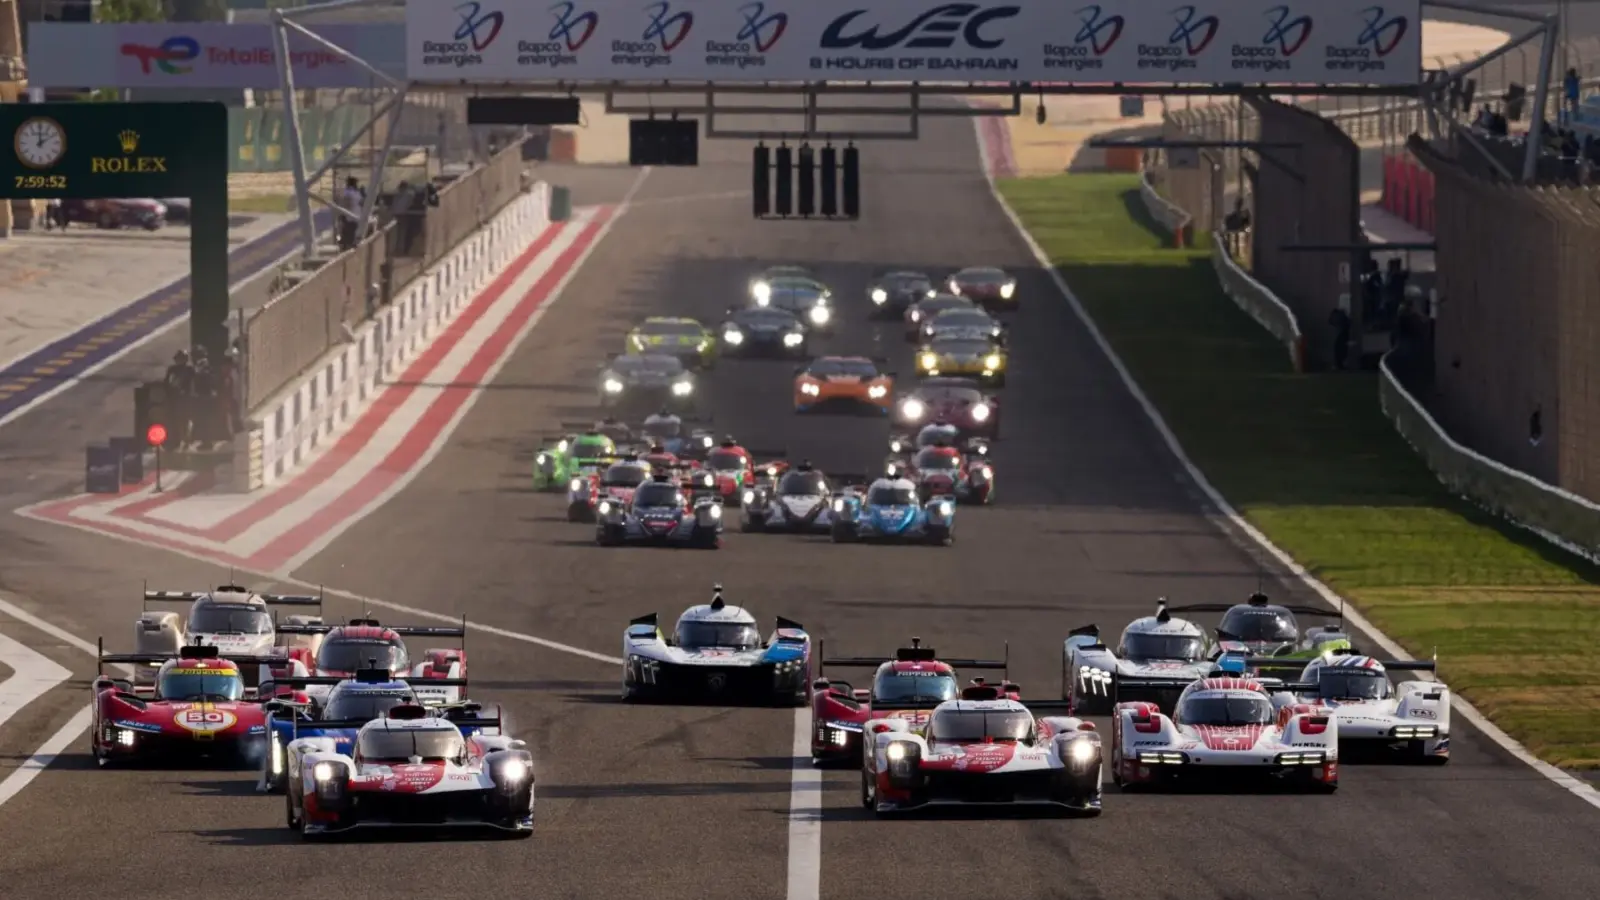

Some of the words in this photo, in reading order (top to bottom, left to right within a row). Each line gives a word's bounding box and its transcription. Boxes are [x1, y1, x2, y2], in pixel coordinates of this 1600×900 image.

[820, 3, 1021, 49] WEC
[423, 41, 468, 53] Bapco
[517, 41, 561, 53] Bapco
[612, 40, 656, 53] Bapco
[706, 40, 749, 53] Bapco
[1044, 44, 1087, 57] Bapco
[1138, 44, 1182, 57] Bapco
[1232, 44, 1276, 57] Bapco
[1326, 45, 1370, 57] Bapco
[423, 55, 482, 67] energies
[517, 55, 577, 67] energies
[611, 55, 671, 68] energies
[705, 55, 765, 68] energies
[826, 57, 894, 69] HOURS
[898, 57, 924, 69] OF
[927, 57, 1018, 70] BAHRAIN
[1043, 59, 1102, 71] energies
[1137, 59, 1196, 71] energies
[1231, 59, 1290, 72] energies
[1325, 60, 1385, 72] energies
[92, 157, 167, 173] ROLEX
[15, 176, 66, 188] 7:59:52
[188, 712, 222, 722] 50
